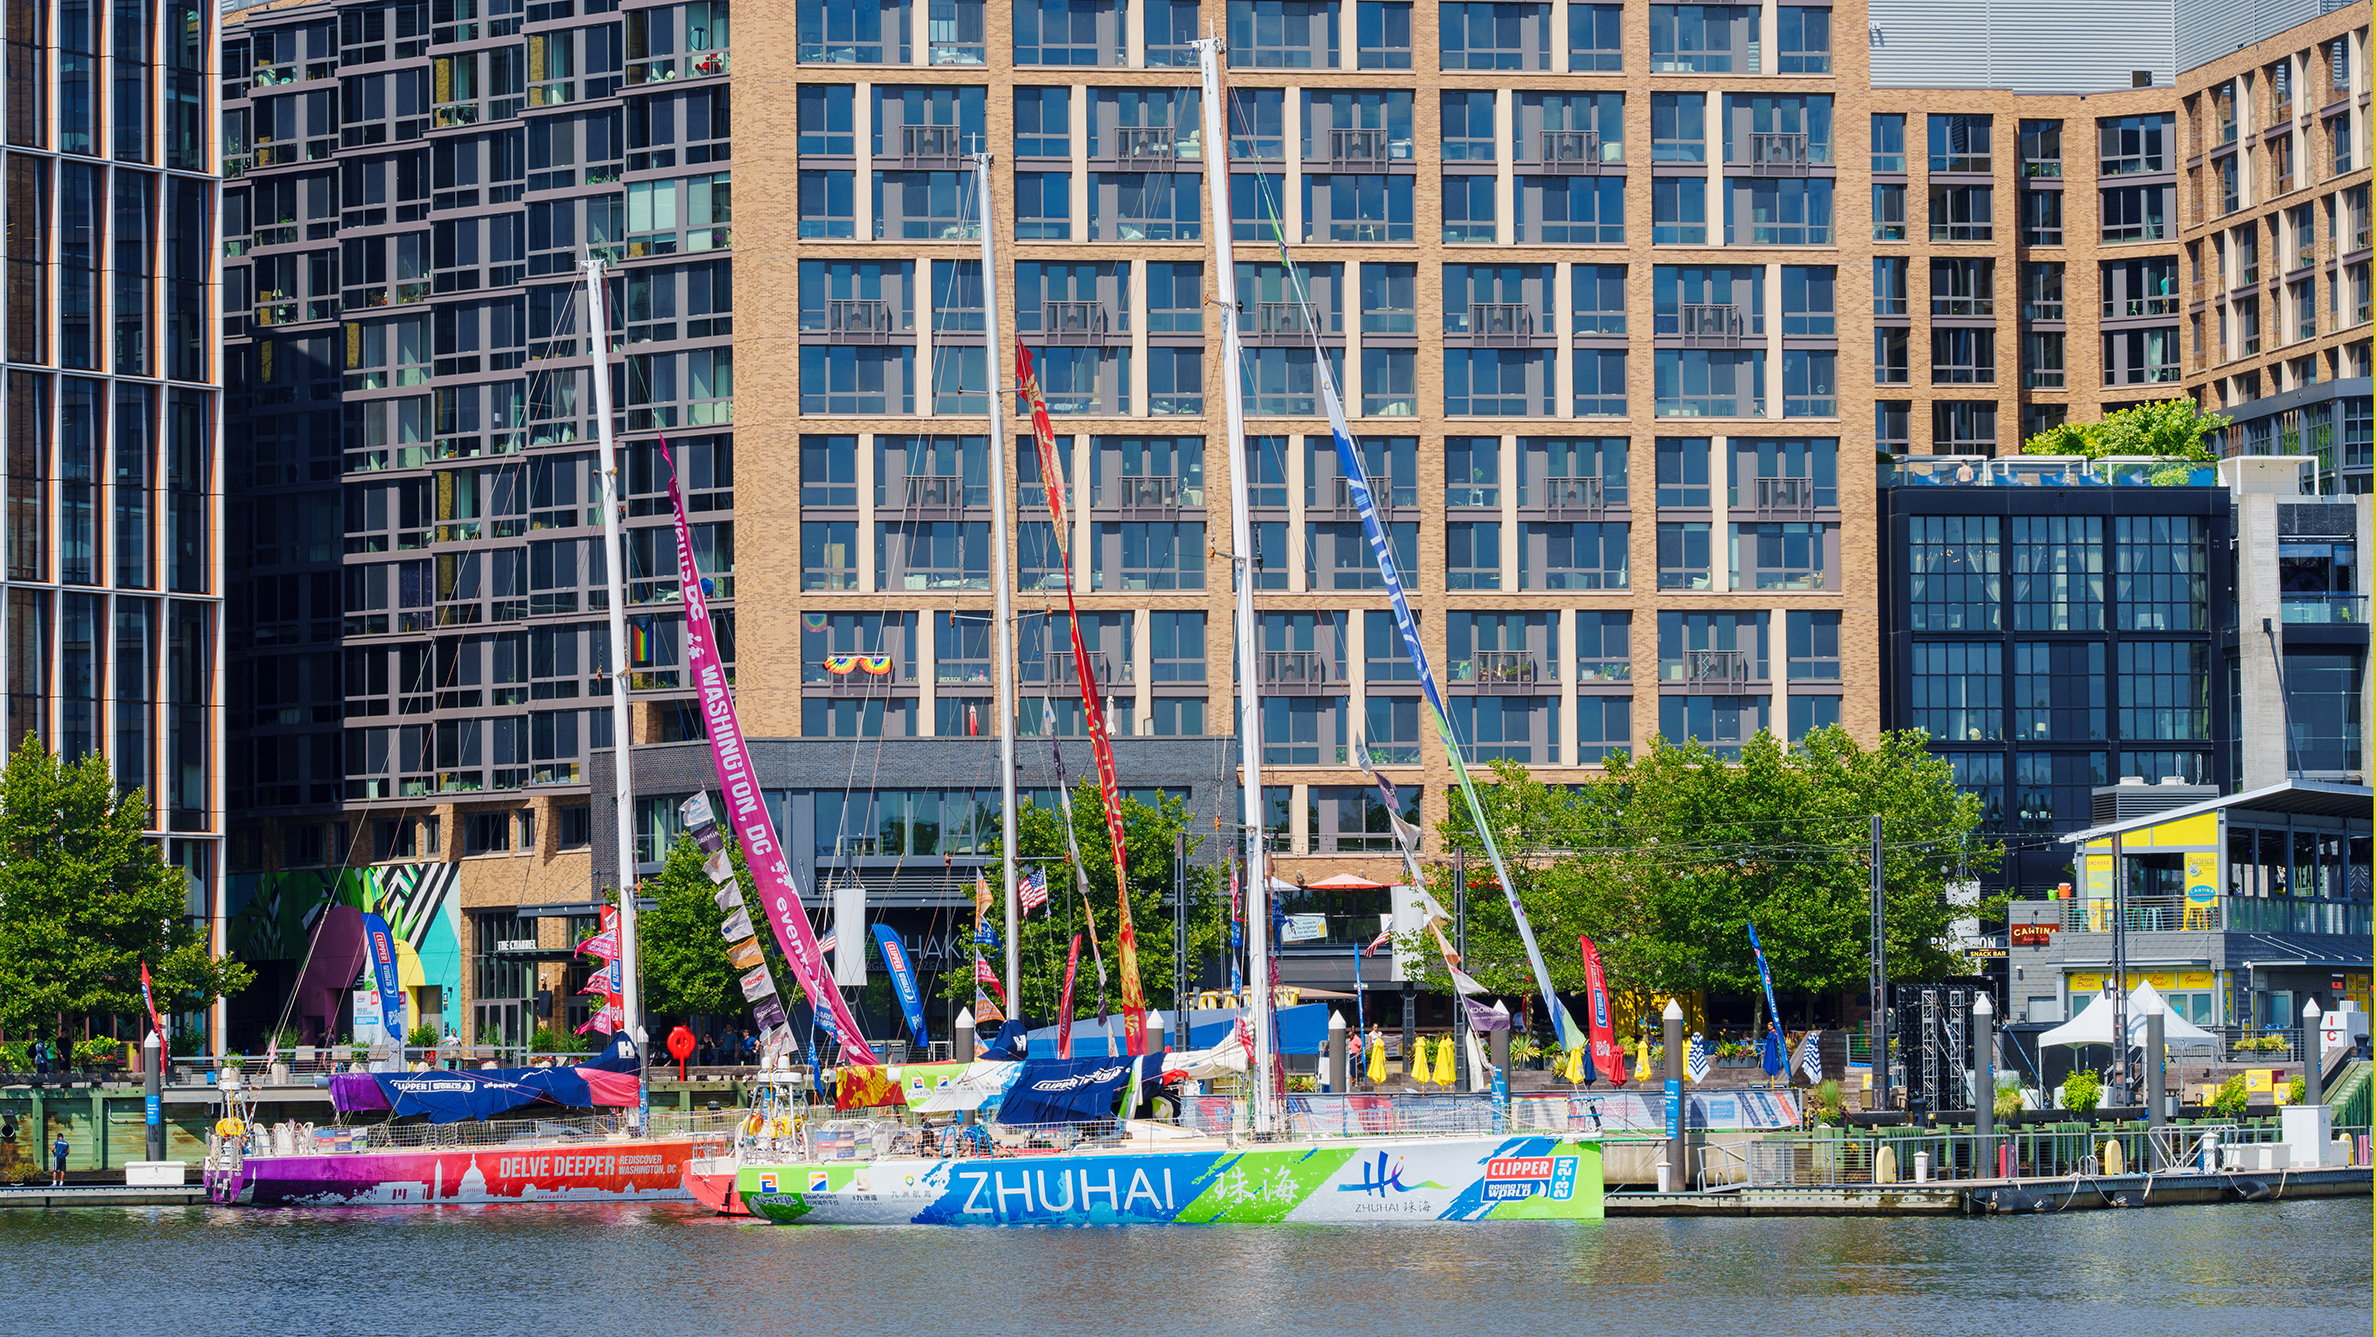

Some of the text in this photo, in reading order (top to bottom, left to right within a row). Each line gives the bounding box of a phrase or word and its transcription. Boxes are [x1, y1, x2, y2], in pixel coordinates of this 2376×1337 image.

[685, 584, 704, 621] DC
[701, 664, 773, 856] WASHINGTON, DC
[375, 934, 388, 961] CLIPPER
[498, 941, 510, 950] THE
[776, 897, 813, 980] events
[904, 935, 971, 959] HAK
[887, 944, 902, 970] CLIPPER
[2185, 976, 2208, 984] Games!
[500, 1156, 615, 1178] DELVE DEEPER
[619, 1164, 676, 1174] WASHINGTON, DC
[620, 1155, 662, 1164] REDISCOVER
[1491, 1161, 1549, 1176] CLIPPER
[1214, 1164, 1301, 1204] 珠海
[1554, 1159, 1573, 1198] 23-24
[959, 1168, 1174, 1214] ZHUHAI
[1488, 1188, 1531, 1197] WORLD
[1355, 1200, 1431, 1213] ZHUHAI 珠海
